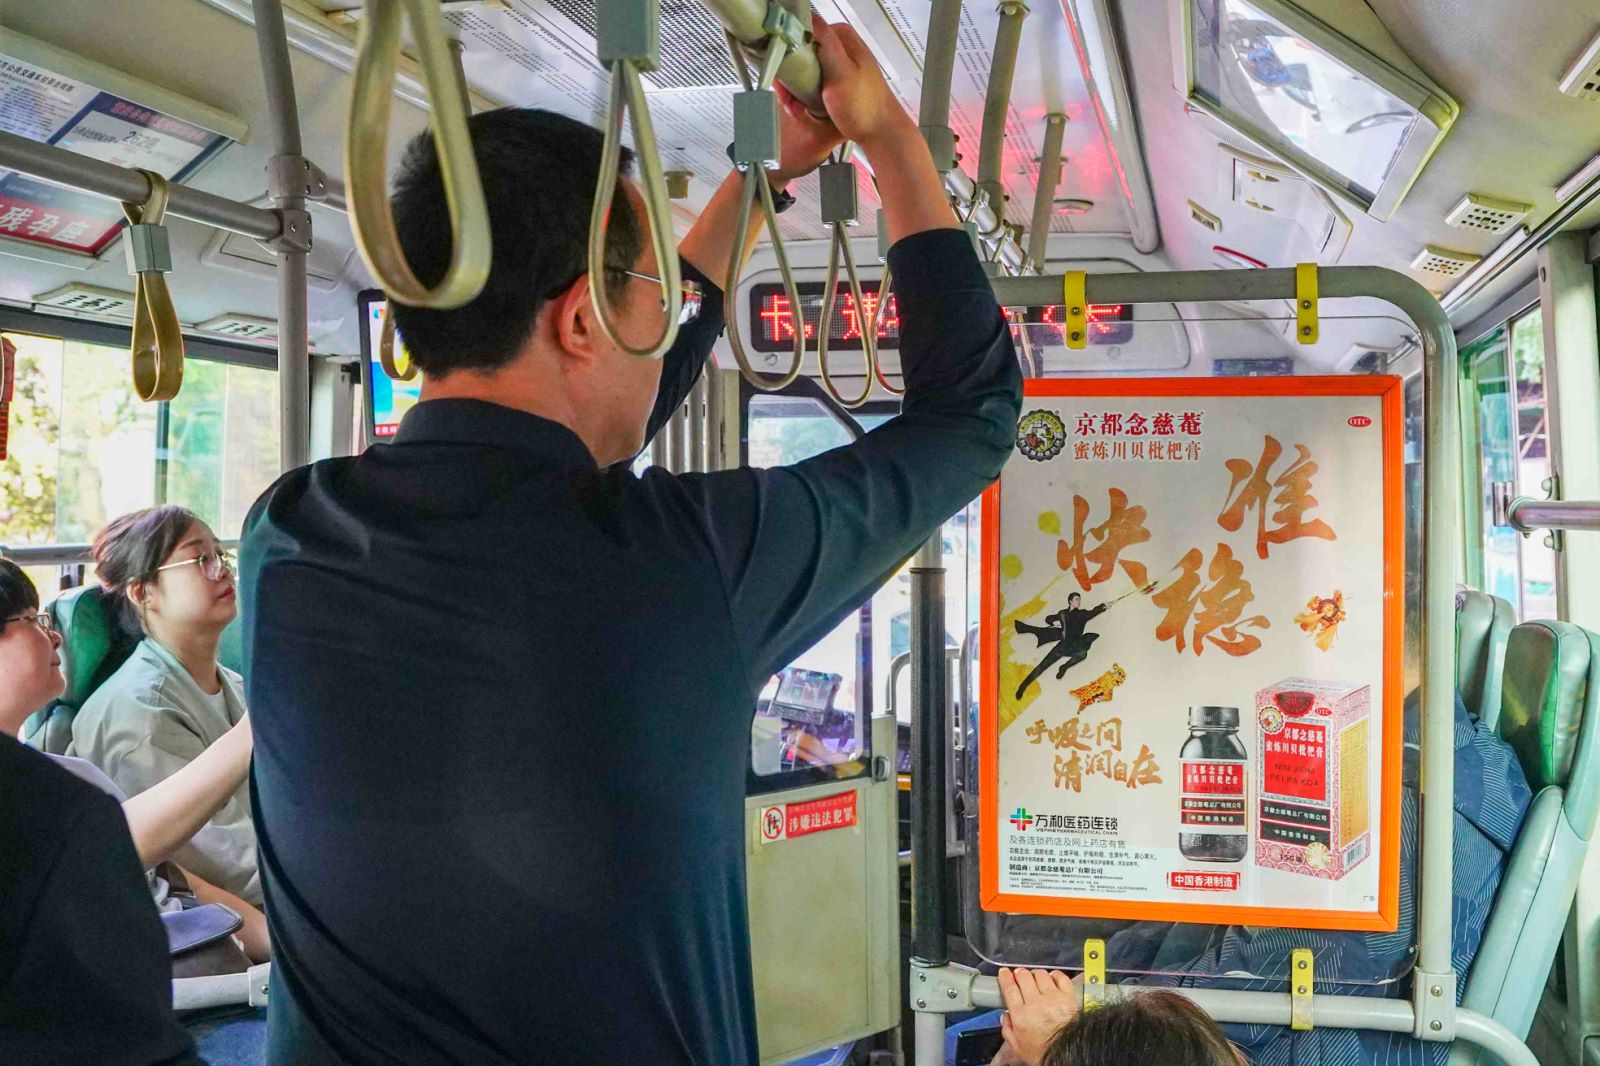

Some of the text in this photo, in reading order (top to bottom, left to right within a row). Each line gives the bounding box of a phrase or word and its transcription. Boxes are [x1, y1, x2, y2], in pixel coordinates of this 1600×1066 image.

[0, 203, 91, 243] 残孕座
[1349, 418, 1370, 427] OTC
[1073, 440, 1202, 461] 蜜炼川贝枇杷膏
[1217, 434, 1338, 560] 准
[1057, 487, 1153, 591] 快
[1151, 543, 1271, 658] 稳
[1026, 717, 1122, 751] 呼吸之间
[1053, 744, 1163, 793] 清润自在
[1035, 813, 1118, 831] 万和医药连锁
[1008, 834, 1126, 849] 及各连锁药店及网上药店有售
[1174, 874, 1234, 888] 中国香港制造
